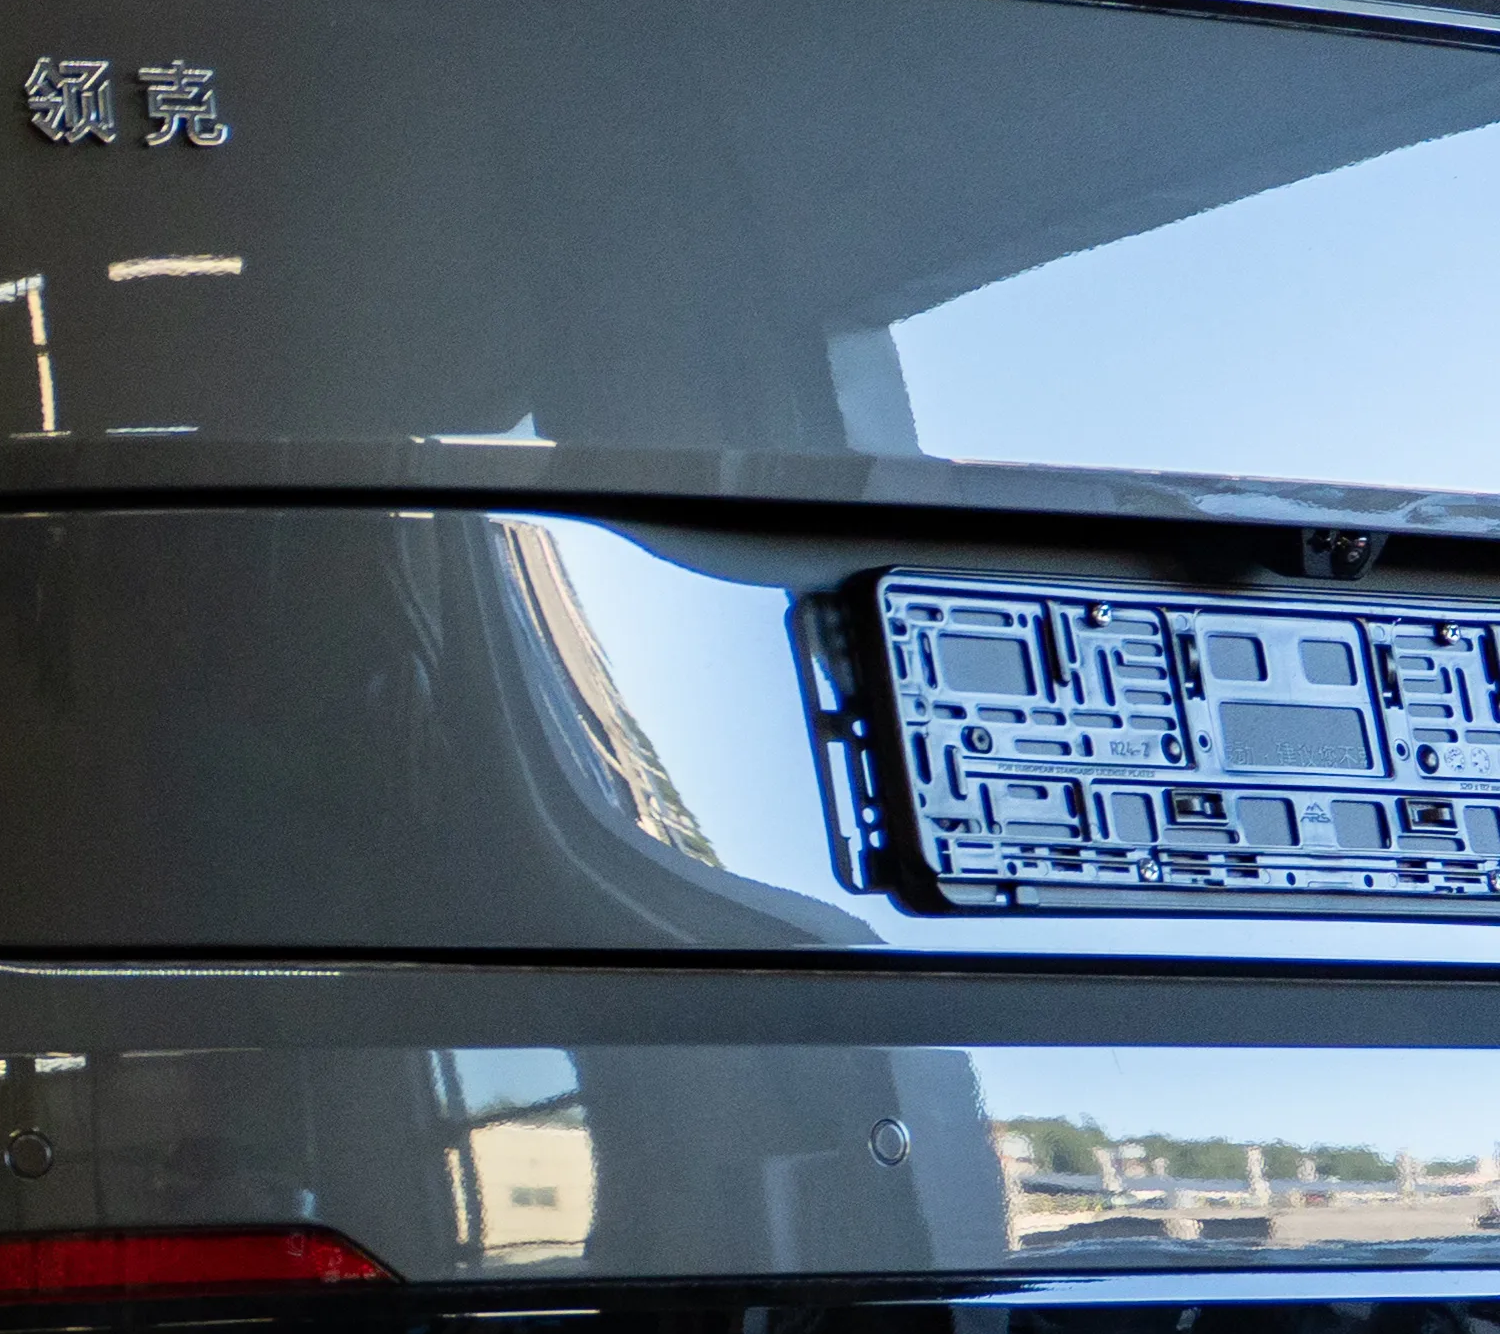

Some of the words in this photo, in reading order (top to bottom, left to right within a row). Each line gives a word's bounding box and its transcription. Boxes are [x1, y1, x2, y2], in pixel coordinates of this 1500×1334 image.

[23, 56, 233, 148] 领克
[1014, 763, 1055, 774] EUROPEAN
[1055, 766, 1094, 776] STANDARD
[1095, 768, 1126, 777] LICENSE
[1127, 769, 1156, 779] PLATES
